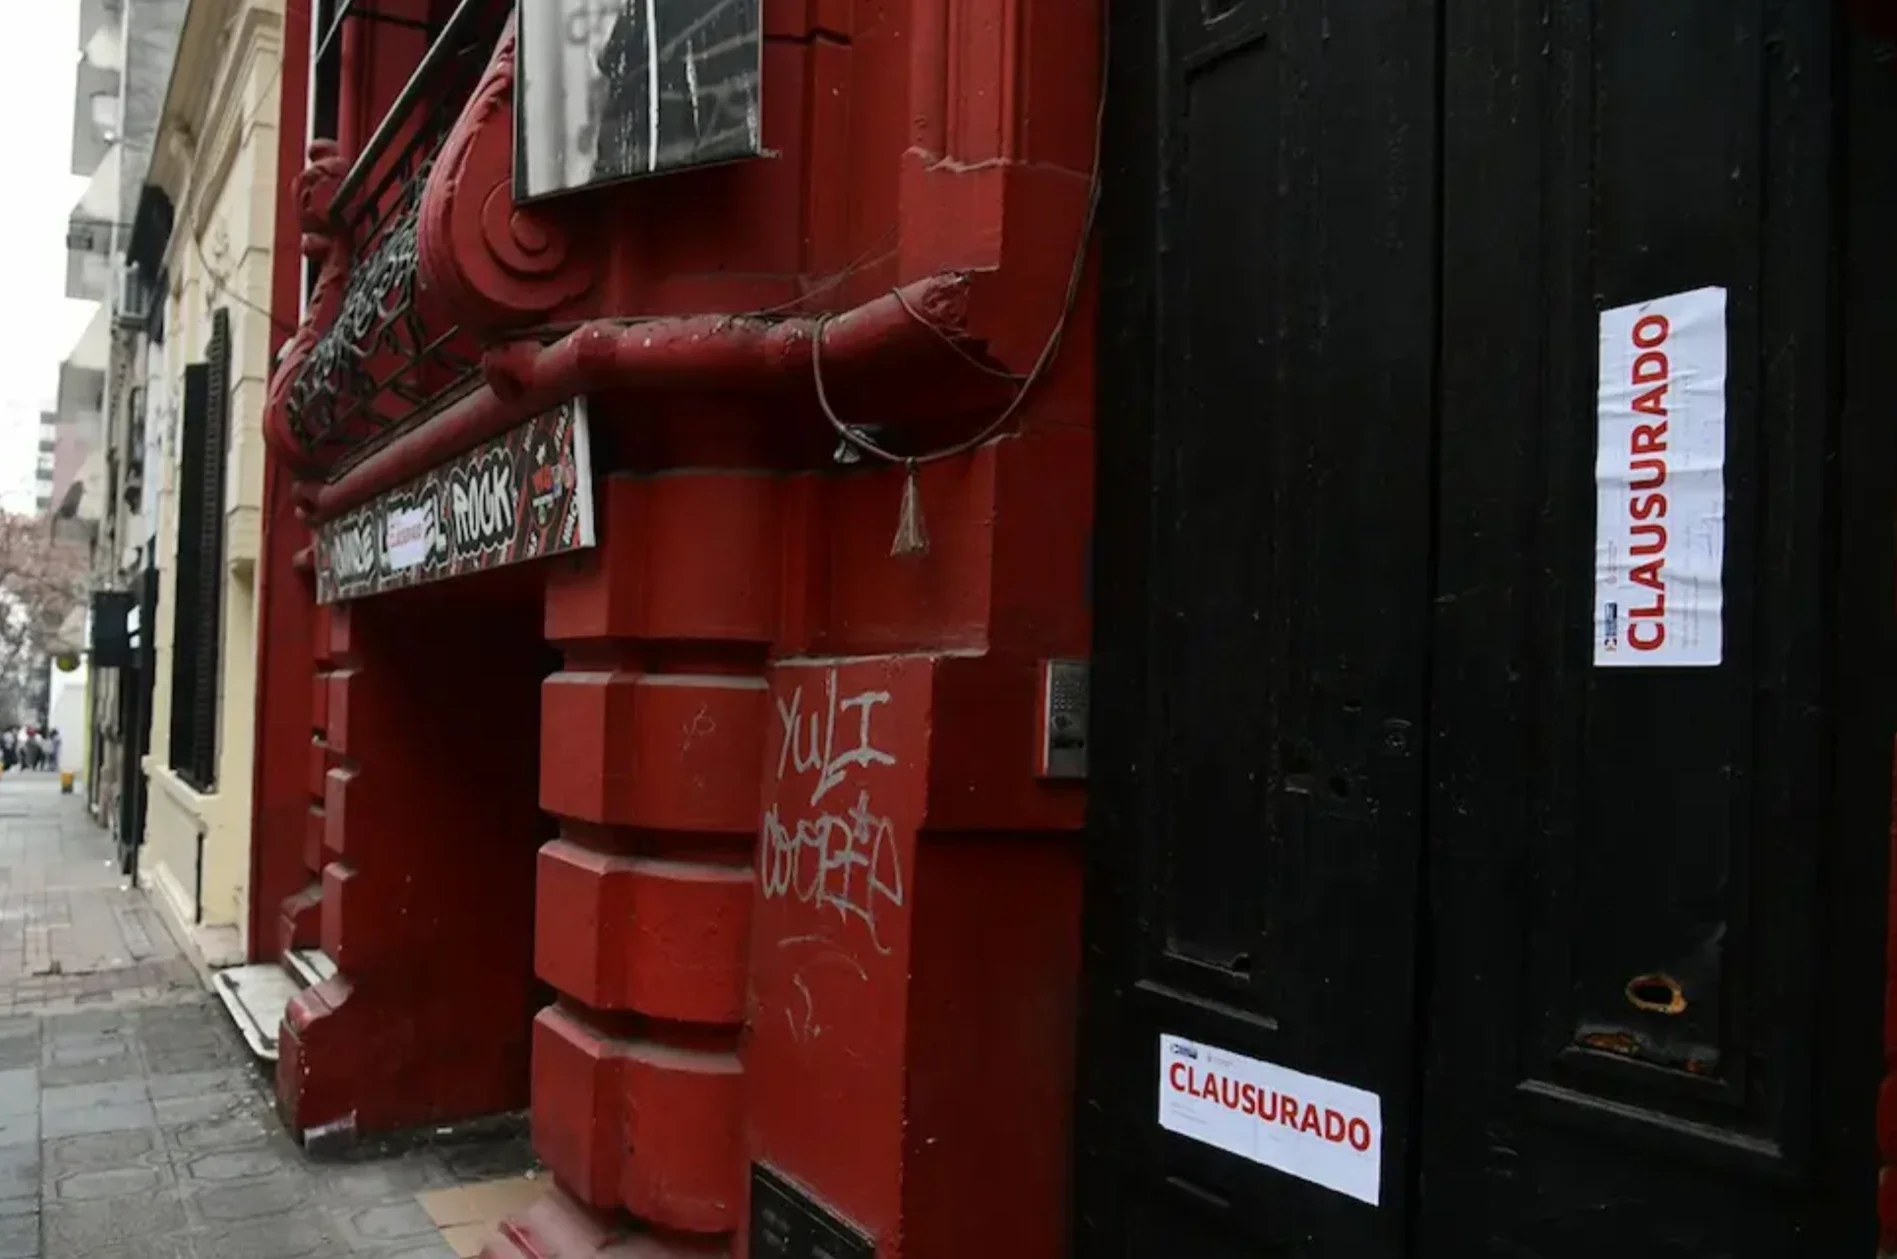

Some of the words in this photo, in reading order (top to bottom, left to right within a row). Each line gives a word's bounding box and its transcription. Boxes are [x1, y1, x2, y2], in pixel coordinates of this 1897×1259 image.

[453, 465, 512, 544] ROCK
[1627, 314, 1669, 651] CLAUSURADO
[1169, 1062, 1371, 1152] CLAUSURADO
